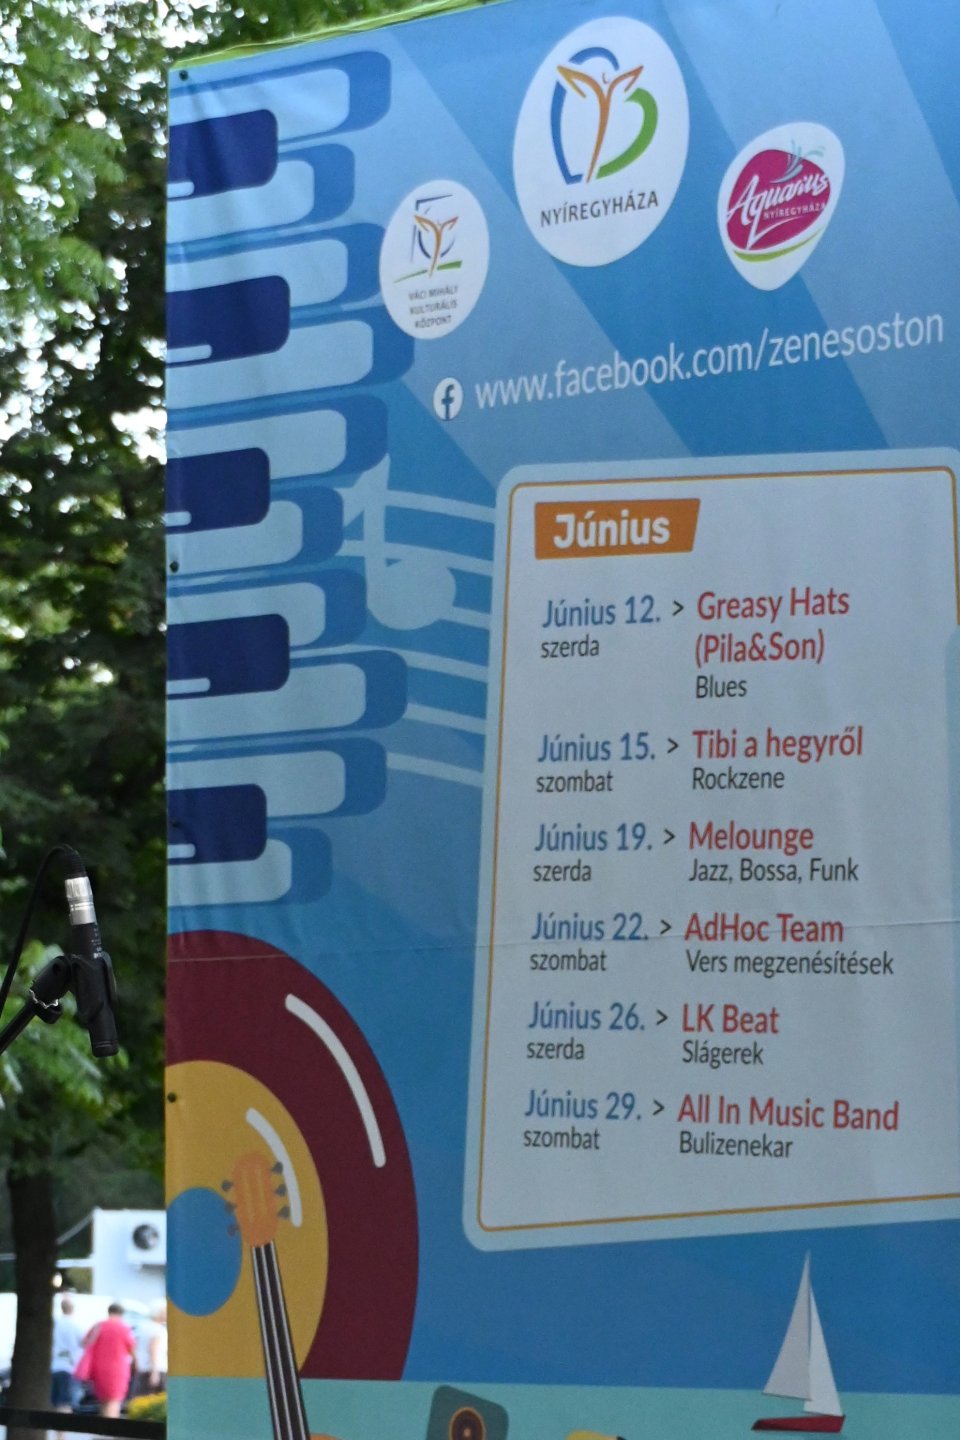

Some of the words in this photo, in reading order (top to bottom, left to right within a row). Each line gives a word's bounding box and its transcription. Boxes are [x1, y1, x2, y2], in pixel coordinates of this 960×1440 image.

[540, 189, 659, 228] NYÍREGYHÁZA
[726, 173, 829, 250] Aquarius
[474, 312, 944, 411] www.facebook.com/zenesoston
[553, 509, 670, 549] Június
[541, 595, 616, 628] Június
[624, 594, 661, 625] 12.
[697, 590, 782, 623] Greasy
[790, 587, 849, 617] Hats
[540, 636, 600, 659] szerda
[694, 629, 825, 669] (Pila&Son)
[695, 675, 747, 699] Blues
[537, 732, 611, 764] Június
[620, 731, 656, 761] 15.
[692, 728, 737, 760] Tibi
[744, 738, 758, 759] a
[765, 725, 864, 765] hegyről
[535, 771, 614, 794] szombat
[692, 767, 785, 791] Rockzene
[533, 823, 608, 852] Június
[617, 822, 653, 851] 19.
[689, 821, 814, 856] Melounge
[533, 859, 592, 882] szerda
[688, 860, 733, 883] Jazz,
[740, 859, 803, 884] Bossa,
[809, 858, 859, 882] Funk
[530, 912, 605, 942] Június
[613, 912, 649, 941] 22.
[684, 912, 769, 943] AdHoc
[776, 912, 844, 943] Team
[529, 949, 607, 972] szombat
[686, 949, 728, 973] Vers
[733, 949, 894, 979] megzenésítések
[528, 1002, 601, 1031] Június
[609, 1003, 645, 1032] 26.
[682, 1003, 715, 1033] LK
[722, 1005, 779, 1034] Beat
[526, 1038, 585, 1060] szerda
[682, 1039, 764, 1069] Slágerek
[524, 1089, 598, 1120] Június
[605, 1092, 642, 1121] 29.
[677, 1094, 709, 1125] All
[718, 1095, 739, 1125] In
[749, 1096, 825, 1129] Music
[832, 1099, 899, 1131] Band
[523, 1127, 600, 1150] szombat
[679, 1131, 793, 1158] Bulizenekar
